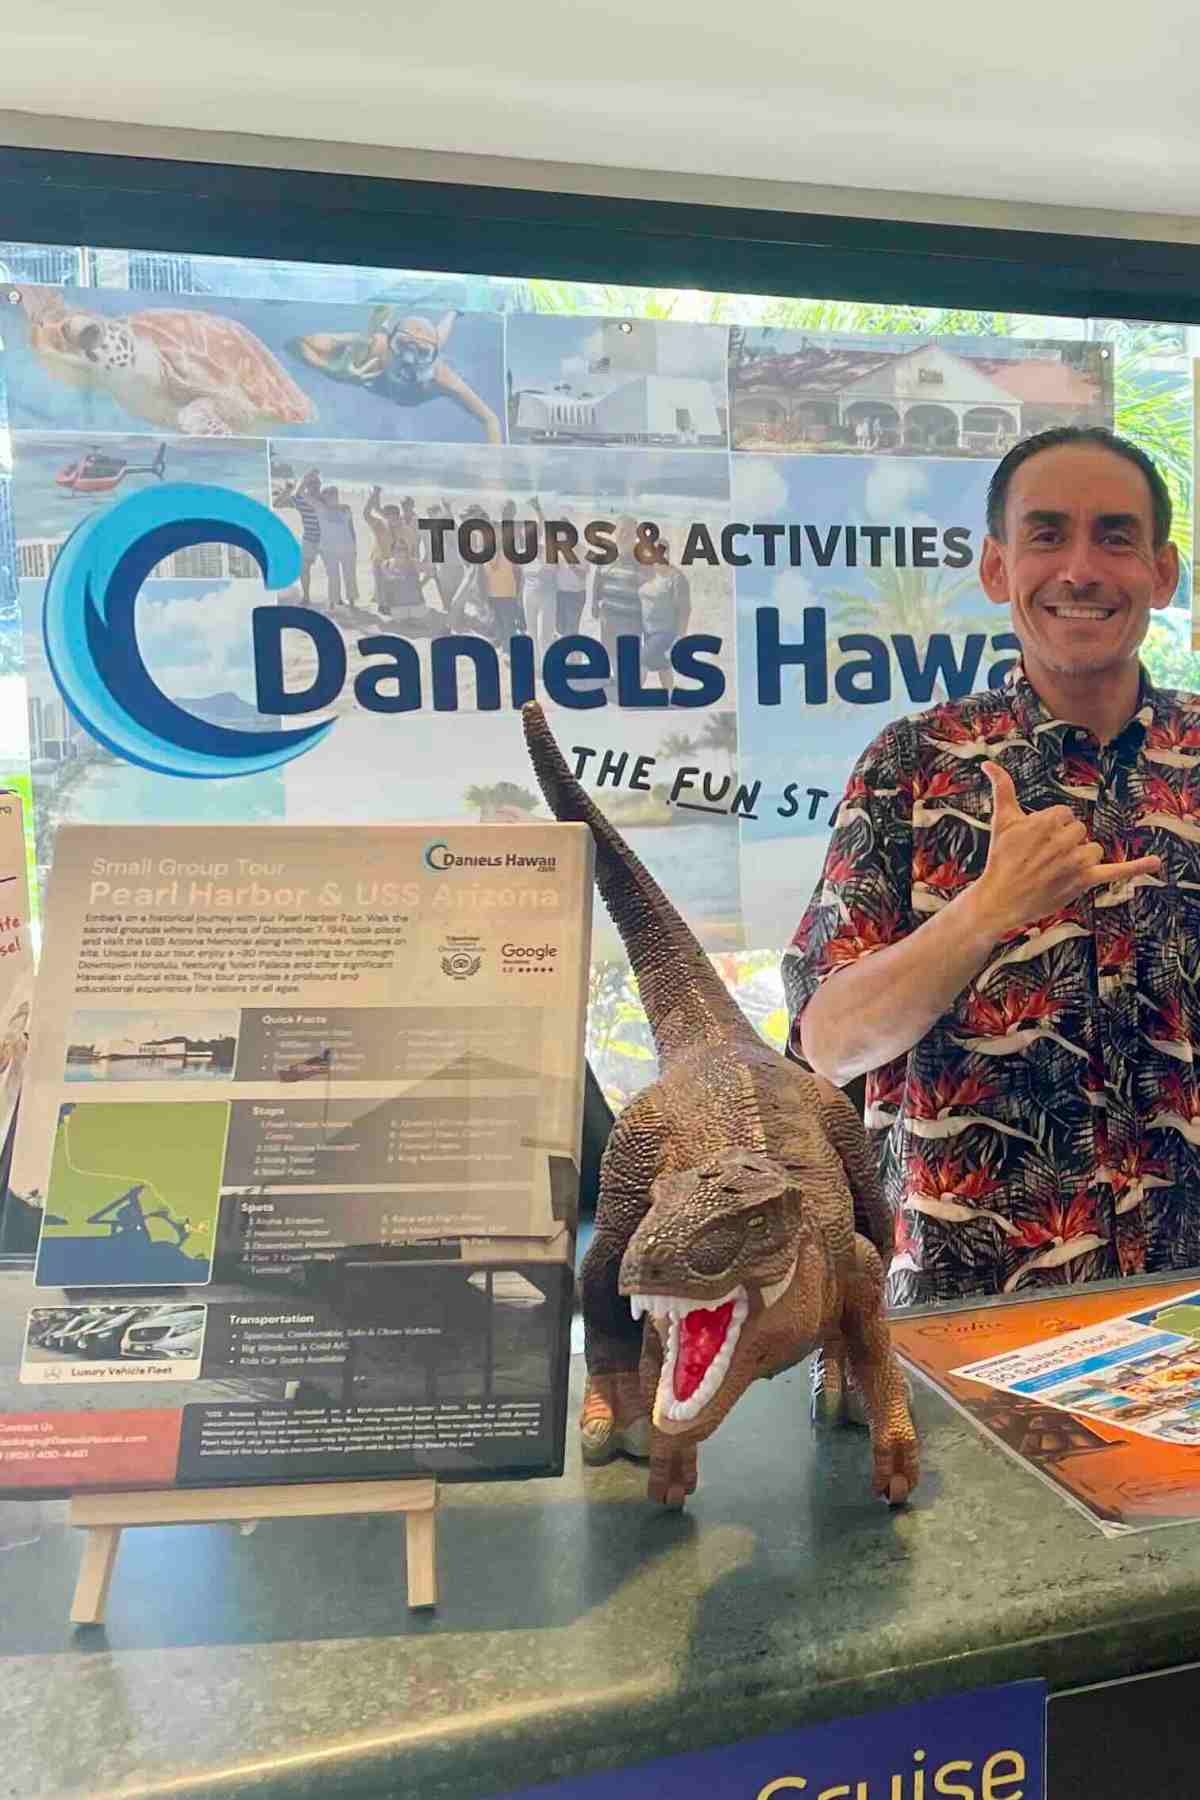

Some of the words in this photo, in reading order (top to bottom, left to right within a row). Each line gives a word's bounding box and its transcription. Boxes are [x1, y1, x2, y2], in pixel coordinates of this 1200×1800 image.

[418, 518, 617, 566] TOURS
[633, 520, 670, 566] &
[681, 523, 973, 568] ACTIVITIES
[571, 746, 657, 791] THE
[671, 765, 762, 816] FUN
[777, 782, 843, 828] ST
[92, 858, 151, 876] Small
[158, 859, 229, 879] Group
[236, 859, 285, 876] Tour
[89, 880, 178, 906] Pearl
[190, 880, 307, 906] Harbor
[319, 880, 342, 906] &
[356, 879, 421, 906] USS
[432, 880, 560, 908] Arizona
[501, 943, 558, 960] Google
[261, 1015, 294, 1025] Quick
[230, 1314, 315, 1326] Transportation
[71, 1367, 105, 1377] Luxury
[109, 1367, 145, 1376] Vehicle
